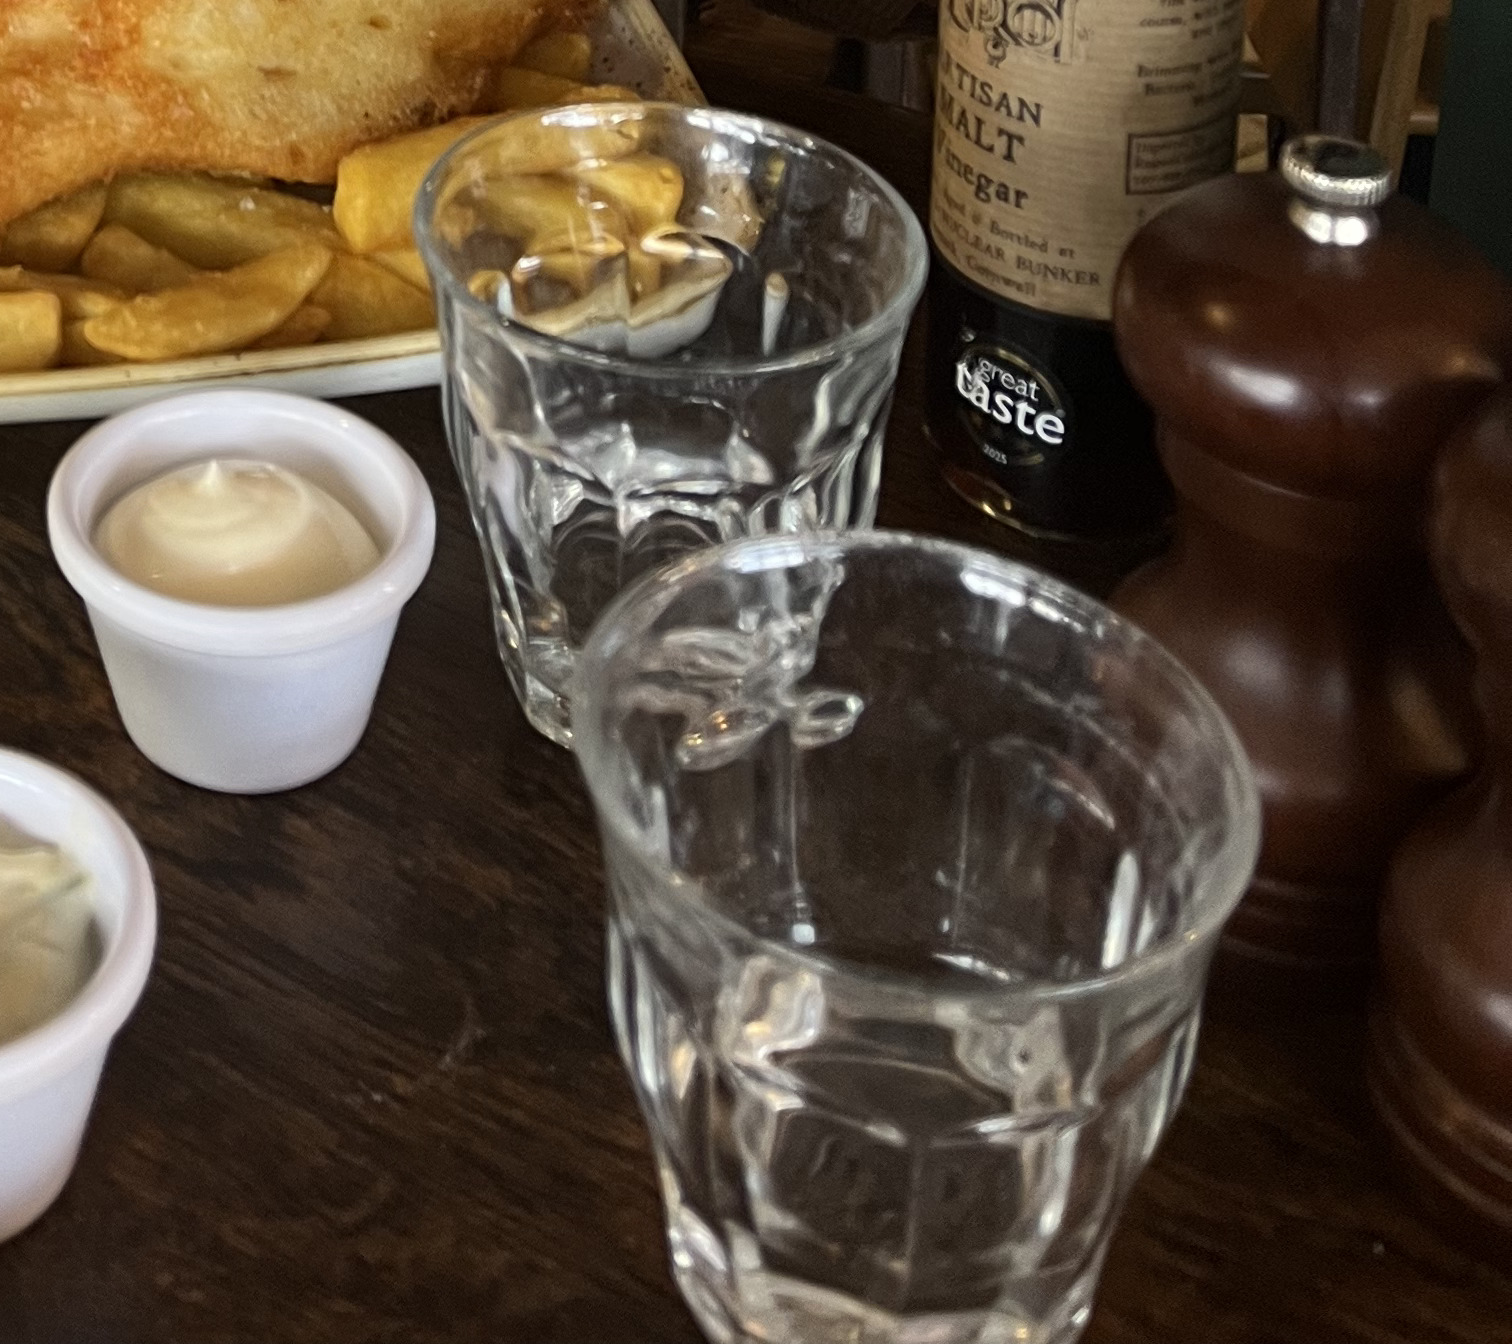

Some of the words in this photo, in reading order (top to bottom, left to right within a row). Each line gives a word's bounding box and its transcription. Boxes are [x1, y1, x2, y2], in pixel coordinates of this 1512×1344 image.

[938, 80, 1026, 166] MALT
[1015, 253, 1102, 287] BUNKER
[955, 361, 1066, 447] taste
[977, 356, 1042, 404] great
